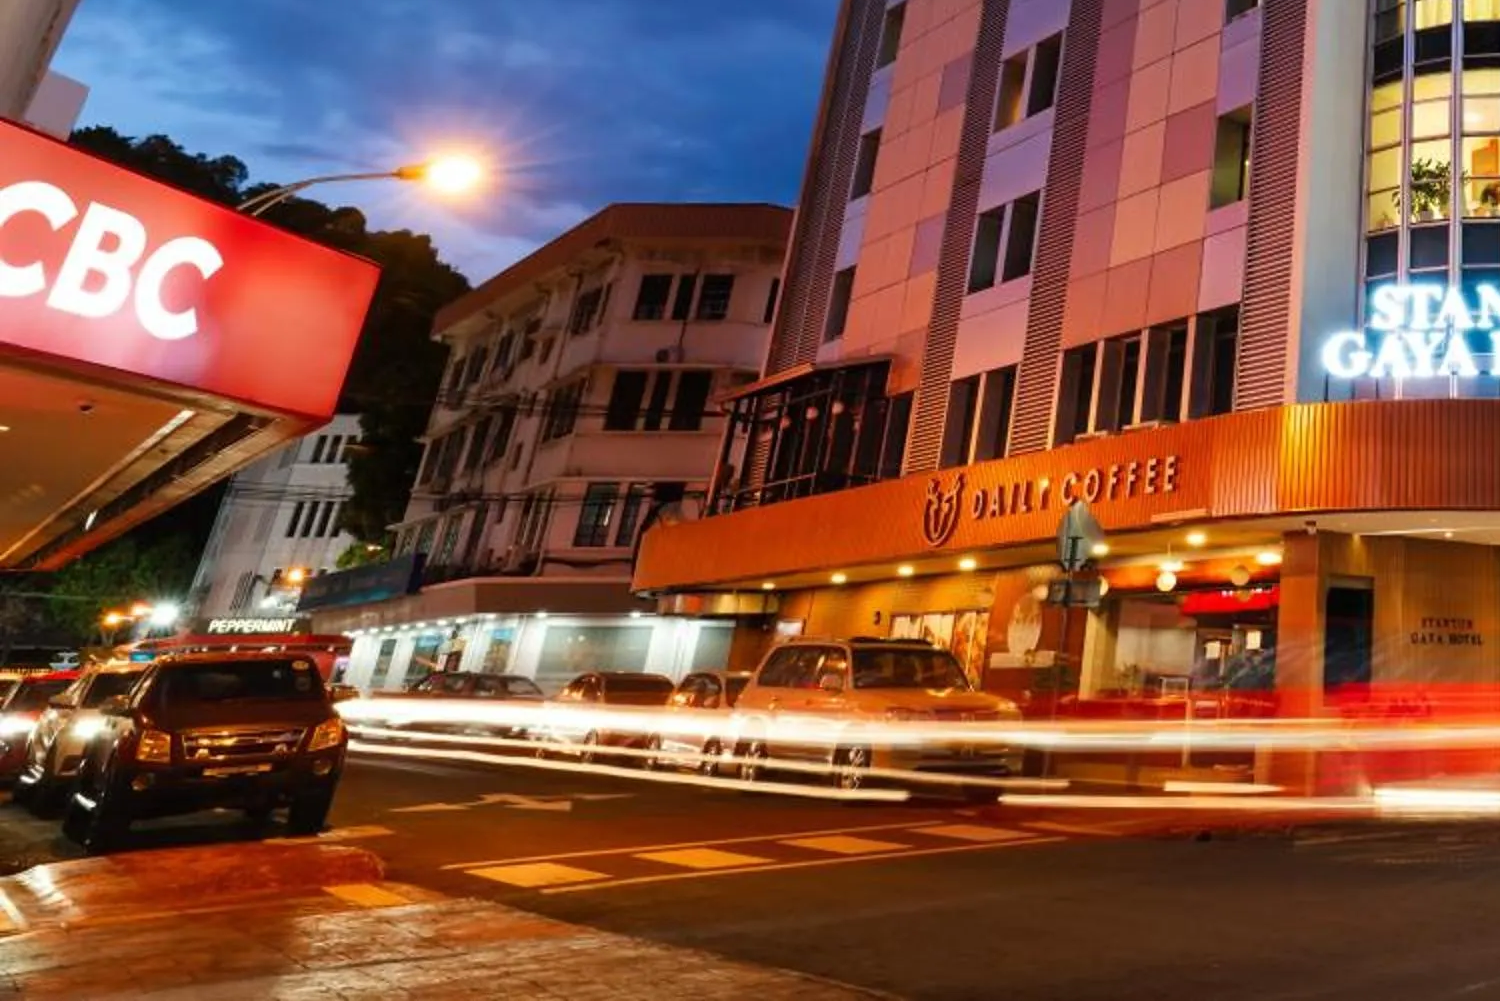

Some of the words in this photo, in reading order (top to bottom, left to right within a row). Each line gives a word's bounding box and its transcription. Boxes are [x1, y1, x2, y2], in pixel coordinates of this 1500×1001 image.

[1321, 329, 1476, 378] GAYA
[1062, 455, 1180, 504] COFFEE
[207, 618, 296, 634] PEPPERMINT
